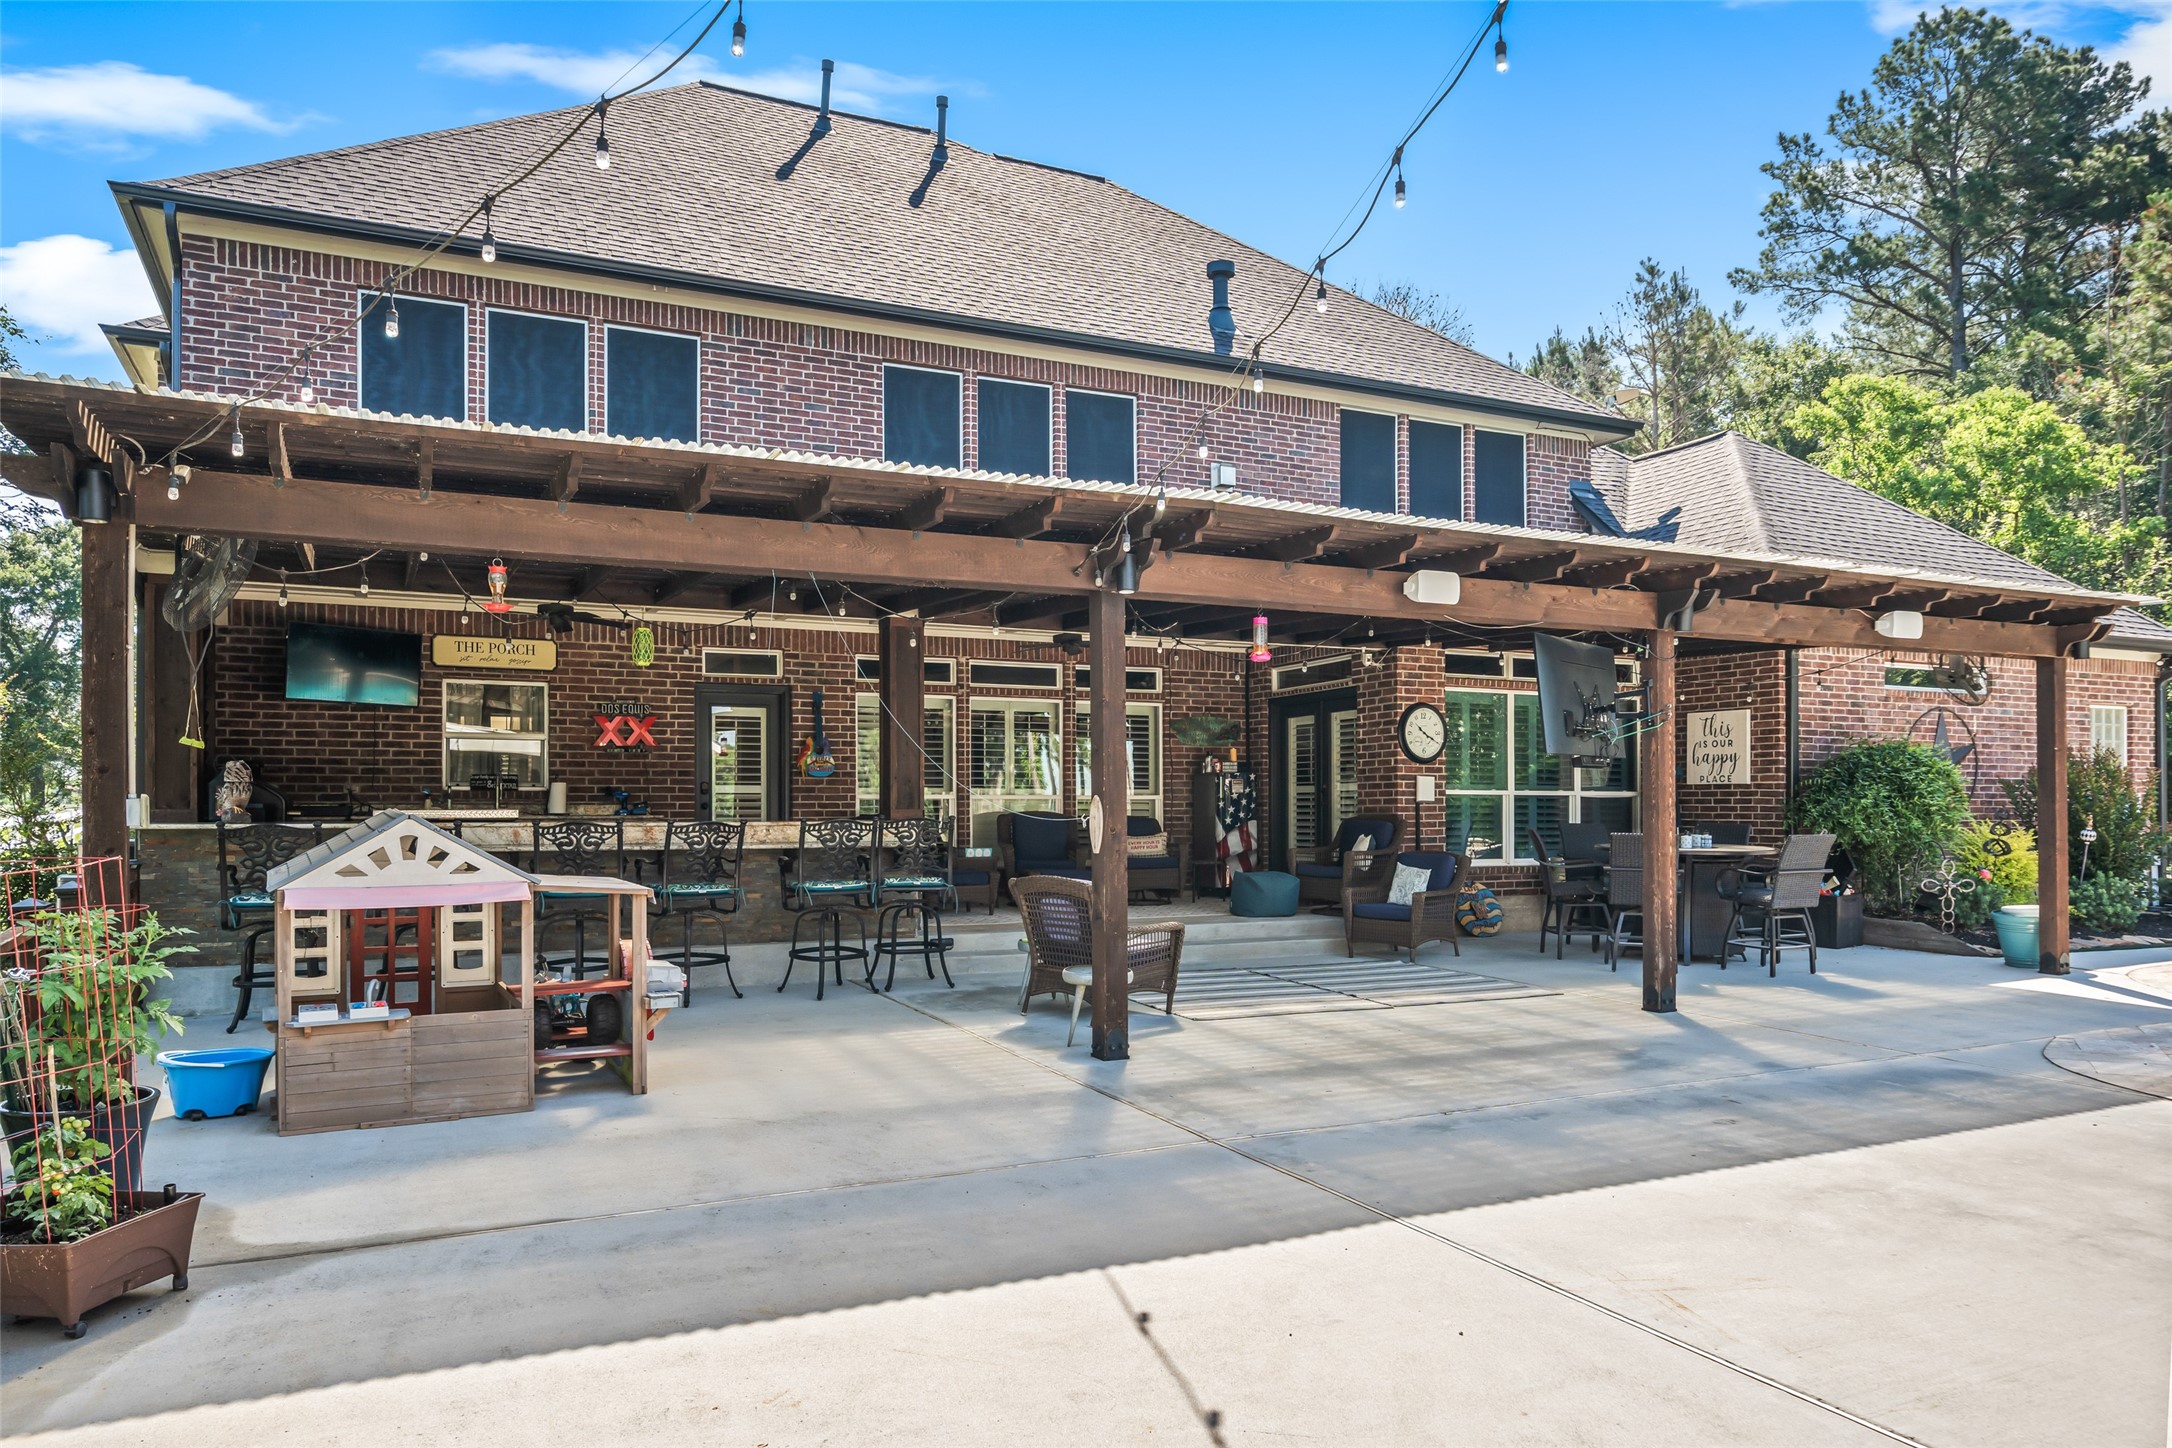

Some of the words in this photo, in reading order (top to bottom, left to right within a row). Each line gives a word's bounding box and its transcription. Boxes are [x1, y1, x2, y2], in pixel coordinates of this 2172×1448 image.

[454, 640, 485, 654] THE
[489, 642, 536, 656] PORCH
[479, 654, 500, 662] relax
[601, 703, 620, 714] DOS
[622, 704, 650, 715] EQUIS
[1420, 712, 1427, 720] 12
[592, 715, 658, 747] XX
[1699, 740, 1708, 748] IS
[1711, 739, 1733, 748] OUR
[1421, 746, 1427, 755] 6
[1692, 742, 1741, 777] happy
[1699, 774, 1732, 783] PLACE
